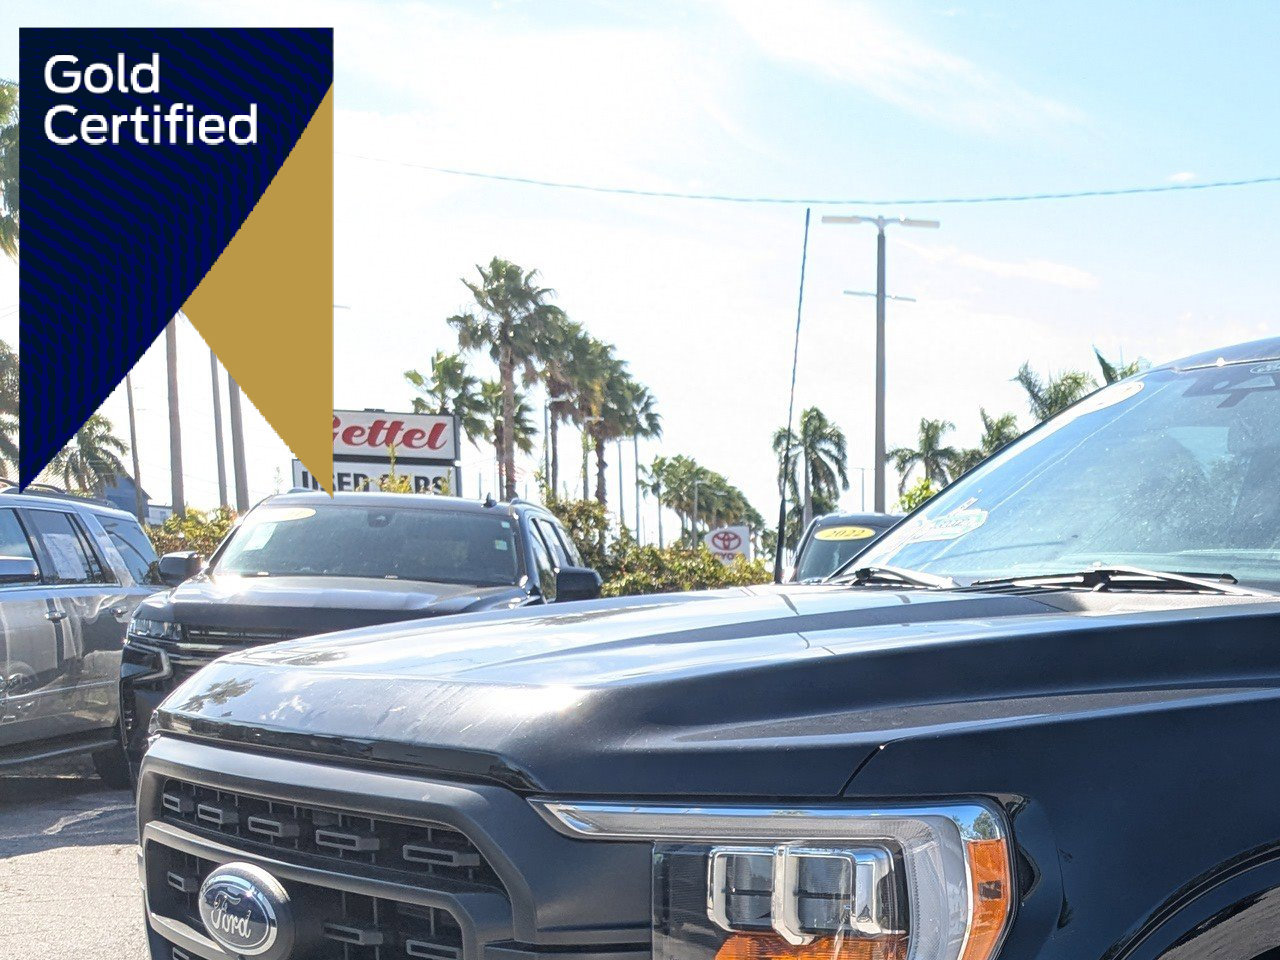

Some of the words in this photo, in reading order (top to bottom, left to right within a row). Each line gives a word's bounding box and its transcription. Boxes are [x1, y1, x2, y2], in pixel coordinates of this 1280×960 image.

[333, 415, 448, 450] ettel
[302, 471, 369, 492] UED
[380, 474, 449, 496] RS
[210, 890, 252, 938] Ford
